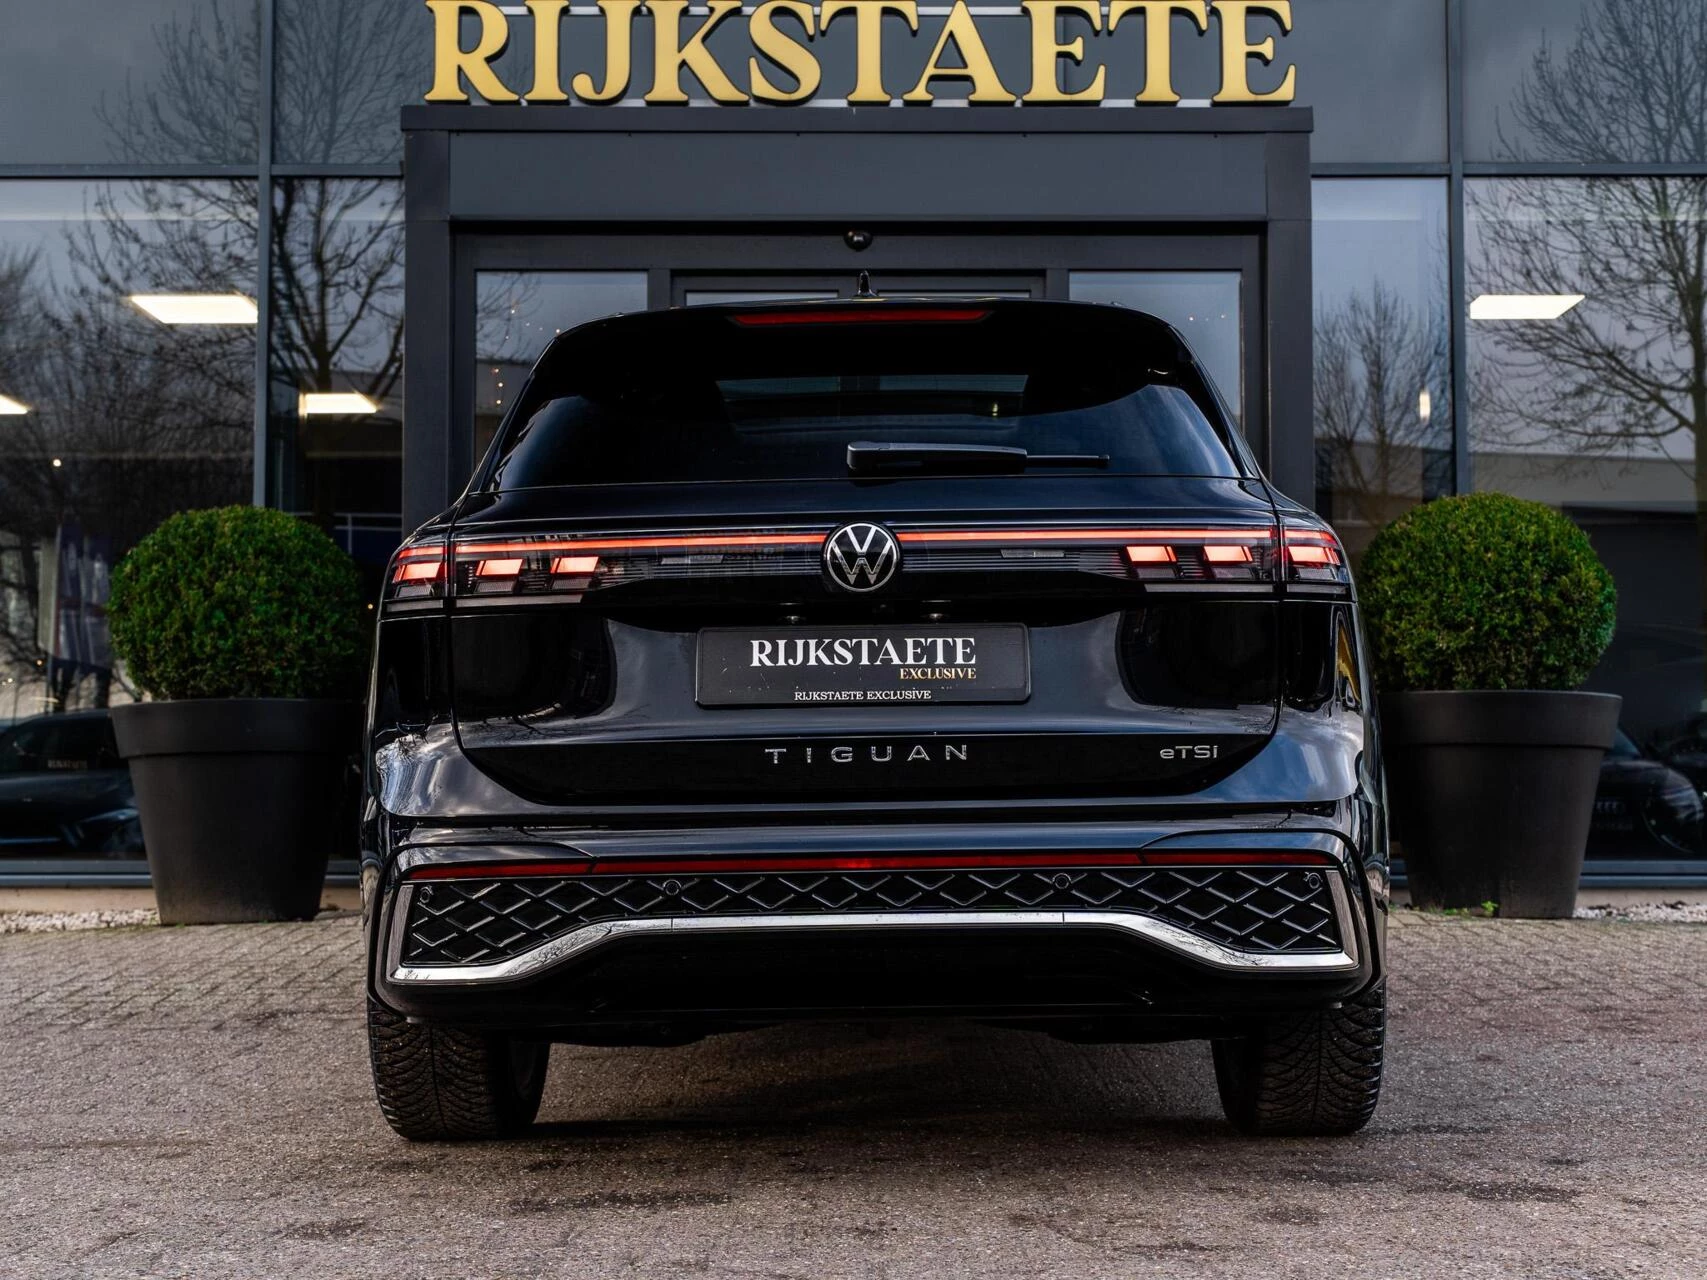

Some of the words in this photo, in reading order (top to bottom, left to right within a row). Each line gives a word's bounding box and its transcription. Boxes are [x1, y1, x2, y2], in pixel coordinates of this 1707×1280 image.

[424, 0, 1296, 105] RIJKSTAETE
[830, 526, 894, 586] VW
[750, 637, 976, 667] RIJKSTAETE
[900, 667, 977, 680] EXCLUSIVE
[794, 690, 864, 701] RIJKSTAETE
[867, 689, 932, 700] EXCLUSIVE
[765, 744, 968, 765] TIGUAN
